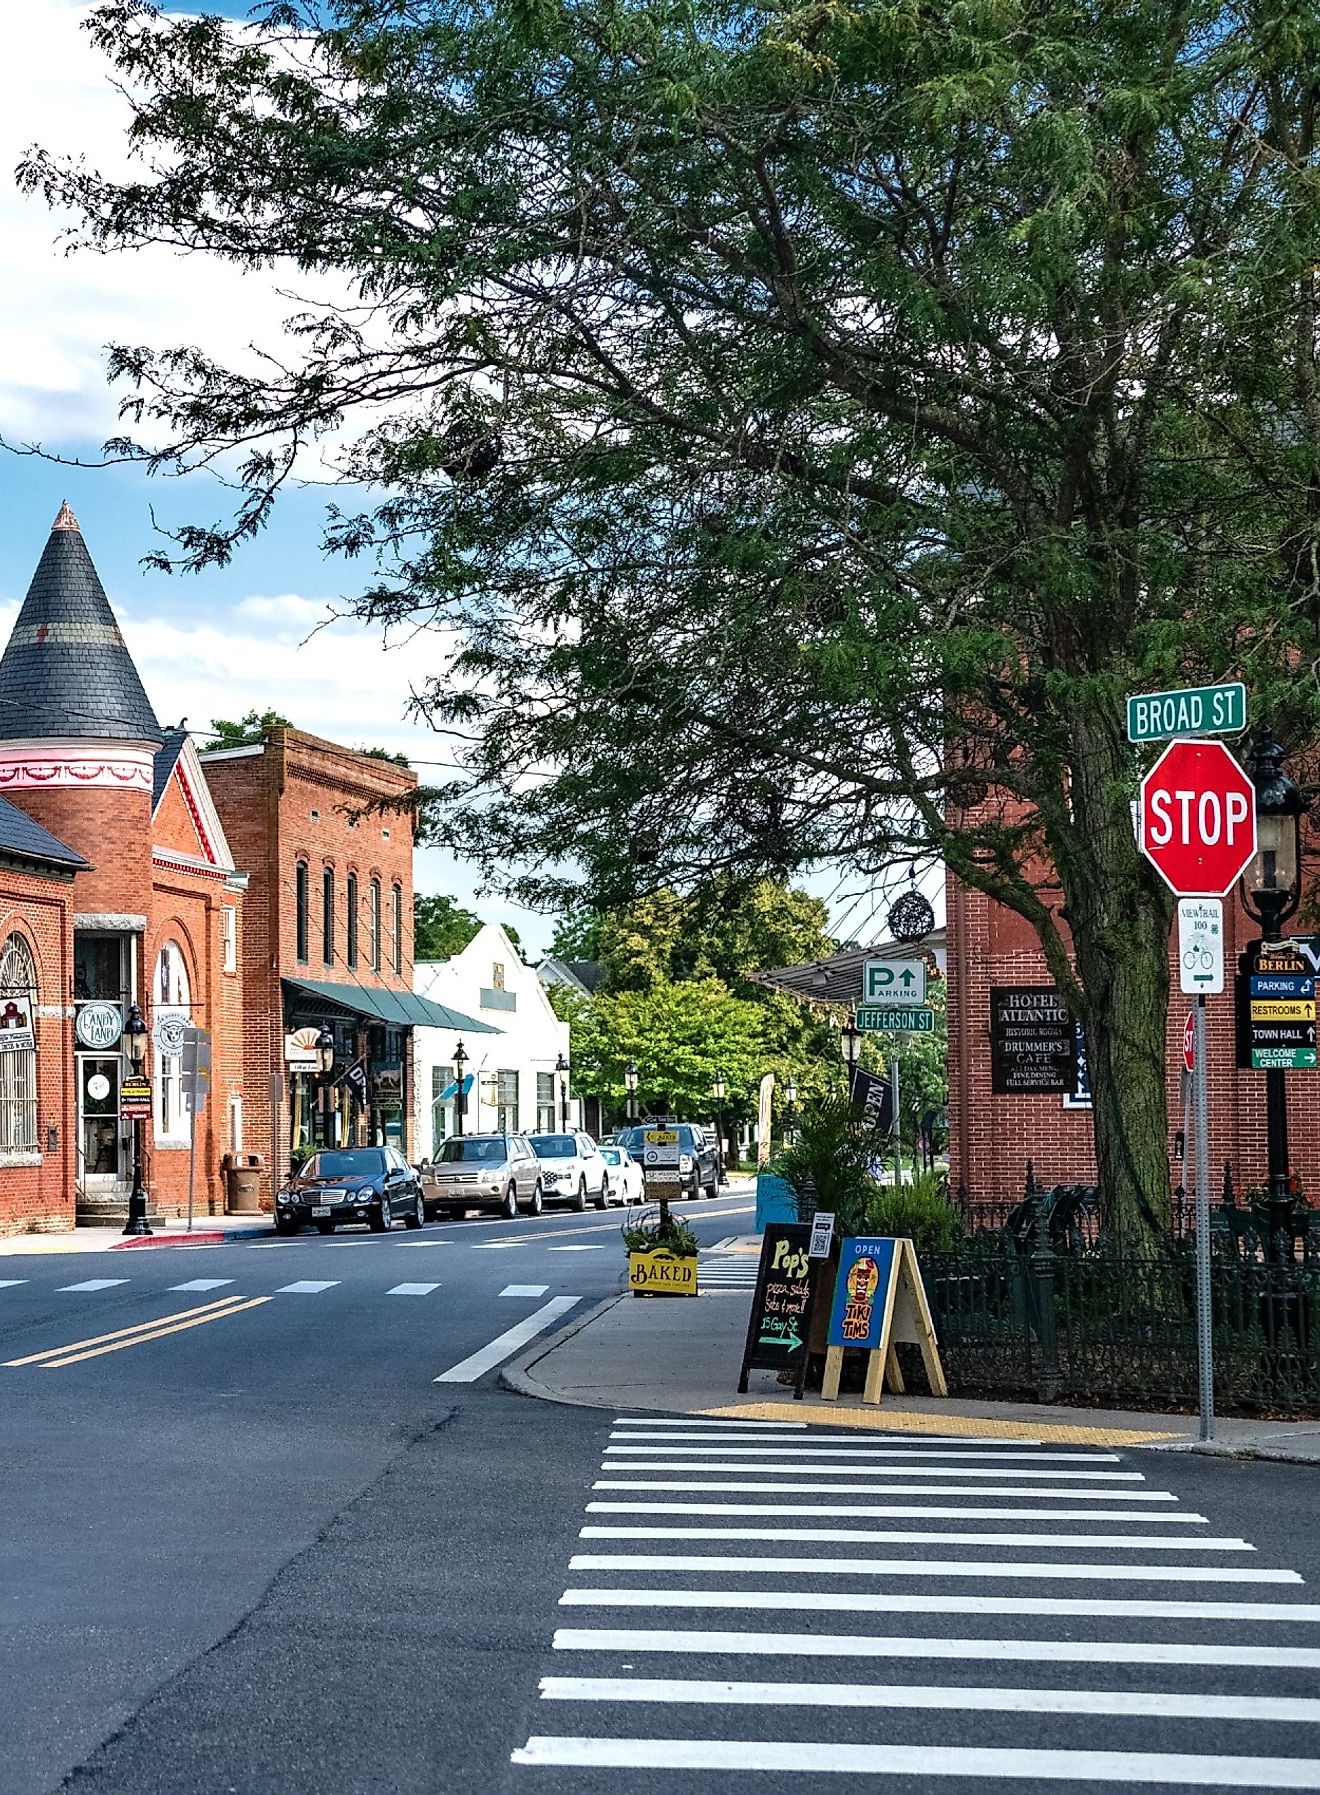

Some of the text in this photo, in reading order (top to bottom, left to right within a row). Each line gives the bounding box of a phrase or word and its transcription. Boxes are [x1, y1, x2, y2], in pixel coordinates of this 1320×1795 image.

[1136, 691, 1236, 735] BROAD ST
[1150, 789, 1249, 846] STOP
[1194, 921, 1208, 930] 100
[1258, 959, 1305, 971] BERLIN
[1257, 981, 1295, 991] PARKING
[1009, 993, 1058, 1008] HOTEL
[1000, 1009, 1067, 1022] ATLANTIC
[1252, 1005, 1302, 1015] RESTROOMS
[83, 1010, 114, 1029] CANDY
[859, 1011, 930, 1029] JEFFERSON ST
[91, 1026, 114, 1042] LAND
[1006, 1027, 1038, 1036] HISTORIC
[1252, 1029, 1303, 1039] TOWN HALL
[1005, 1042, 1063, 1051] DRUMMER'S
[1016, 1053, 1051, 1064] CAFE
[1254, 1048, 1297, 1058] WELCOME
[1259, 1058, 1294, 1067] CENTER
[861, 1081, 884, 1131] OPEN
[855, 1245, 881, 1255] OPEN
[771, 1240, 808, 1278] Pop's
[630, 1263, 692, 1285] BAKED
[761, 1317, 771, 1329] 15
[771, 1316, 788, 1338] Gay
